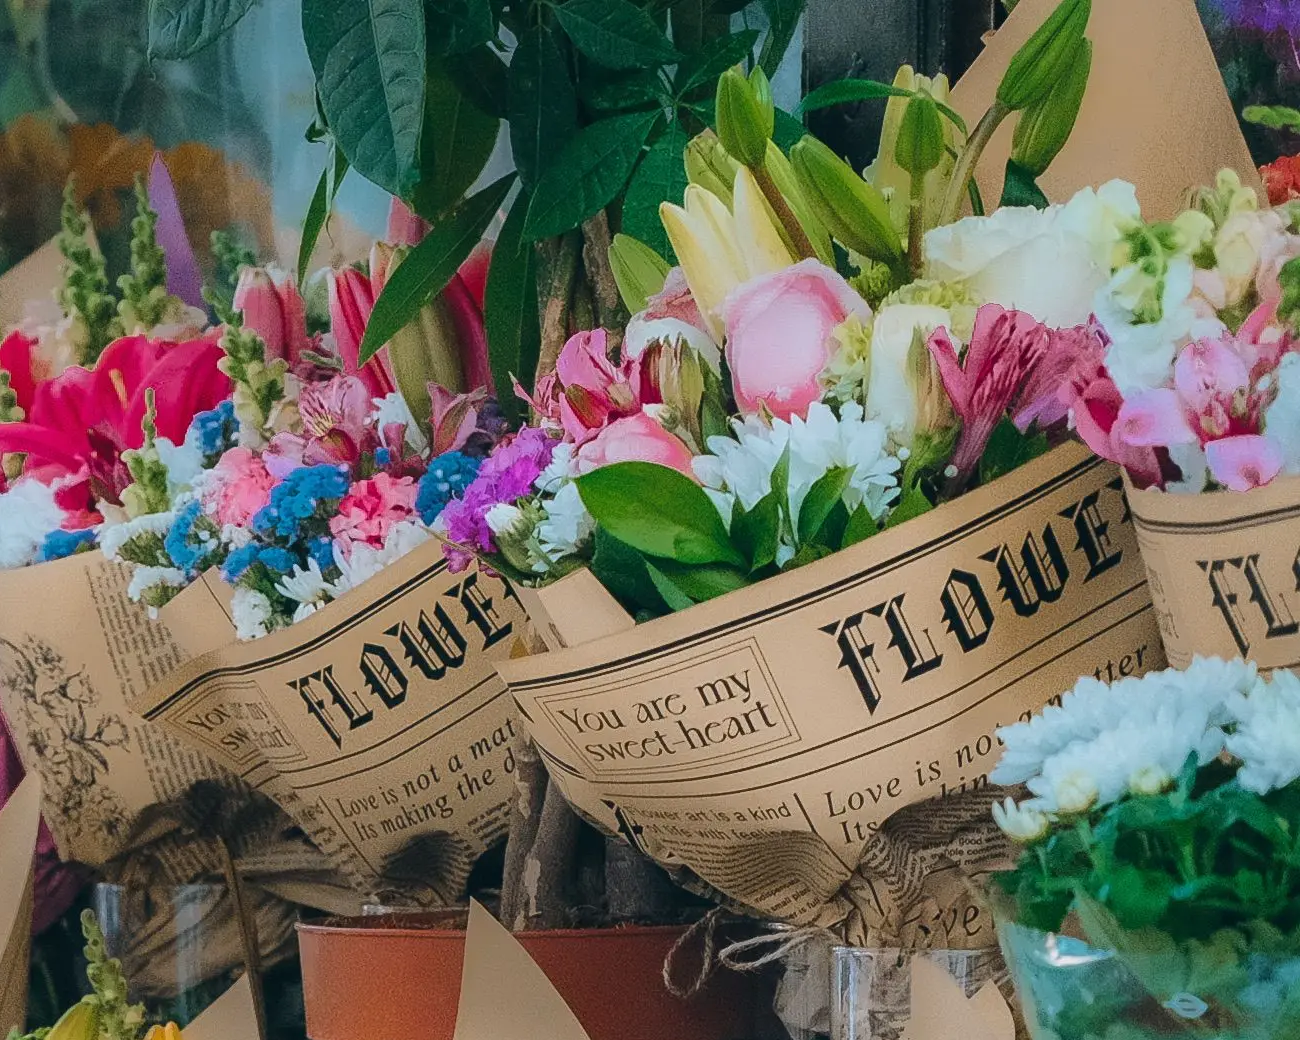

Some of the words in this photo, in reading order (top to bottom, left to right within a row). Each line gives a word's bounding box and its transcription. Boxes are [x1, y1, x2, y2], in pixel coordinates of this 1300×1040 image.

[1195, 552, 1300, 660] FL
[556, 707, 626, 734] You
[631, 692, 687, 724] are
[694, 669, 751, 707] my
[584, 700, 778, 763] sweet-heart
[336, 793, 379, 819] Love
[379, 786, 400, 806] is
[402, 763, 442, 798] not
[448, 753, 464, 773] a
[468, 717, 518, 760] mat
[823, 776, 902, 818] Love
[915, 759, 942, 787] is
[352, 819, 379, 842] Its
[380, 793, 454, 836] making
[456, 767, 496, 801] the
[733, 811, 748, 823] a
[750, 800, 792, 821] kind
[839, 818, 882, 845] Its
